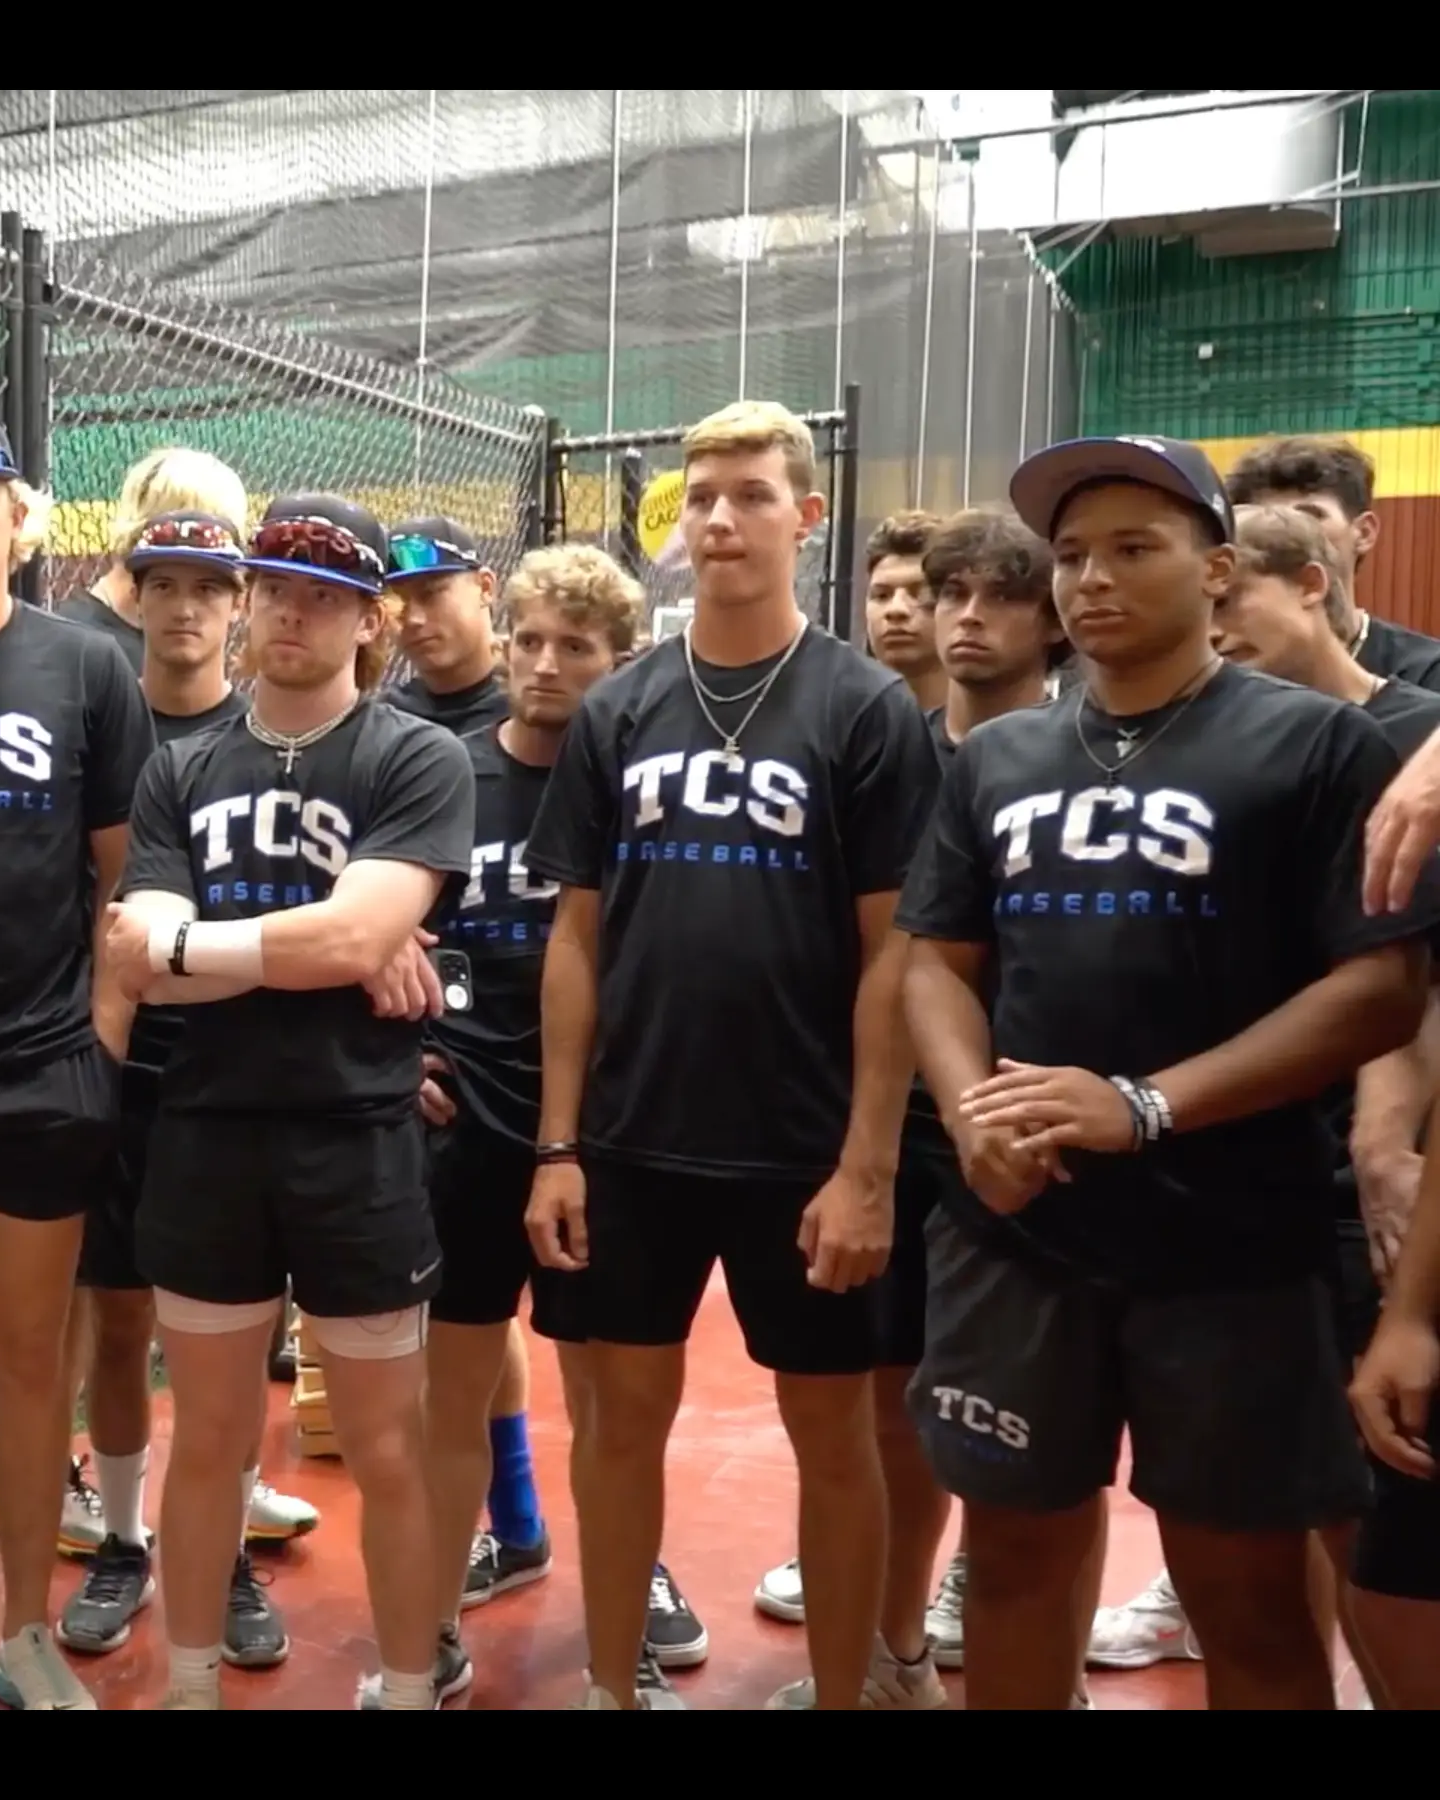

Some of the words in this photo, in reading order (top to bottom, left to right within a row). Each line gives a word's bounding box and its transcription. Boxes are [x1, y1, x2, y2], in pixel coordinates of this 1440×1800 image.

[191, 788, 352, 876] TCS
[623, 749, 809, 836] TCS
[993, 786, 1214, 878] TCS
[617, 841, 810, 871] BASEBALL
[931, 1385, 1031, 1450] TCS
